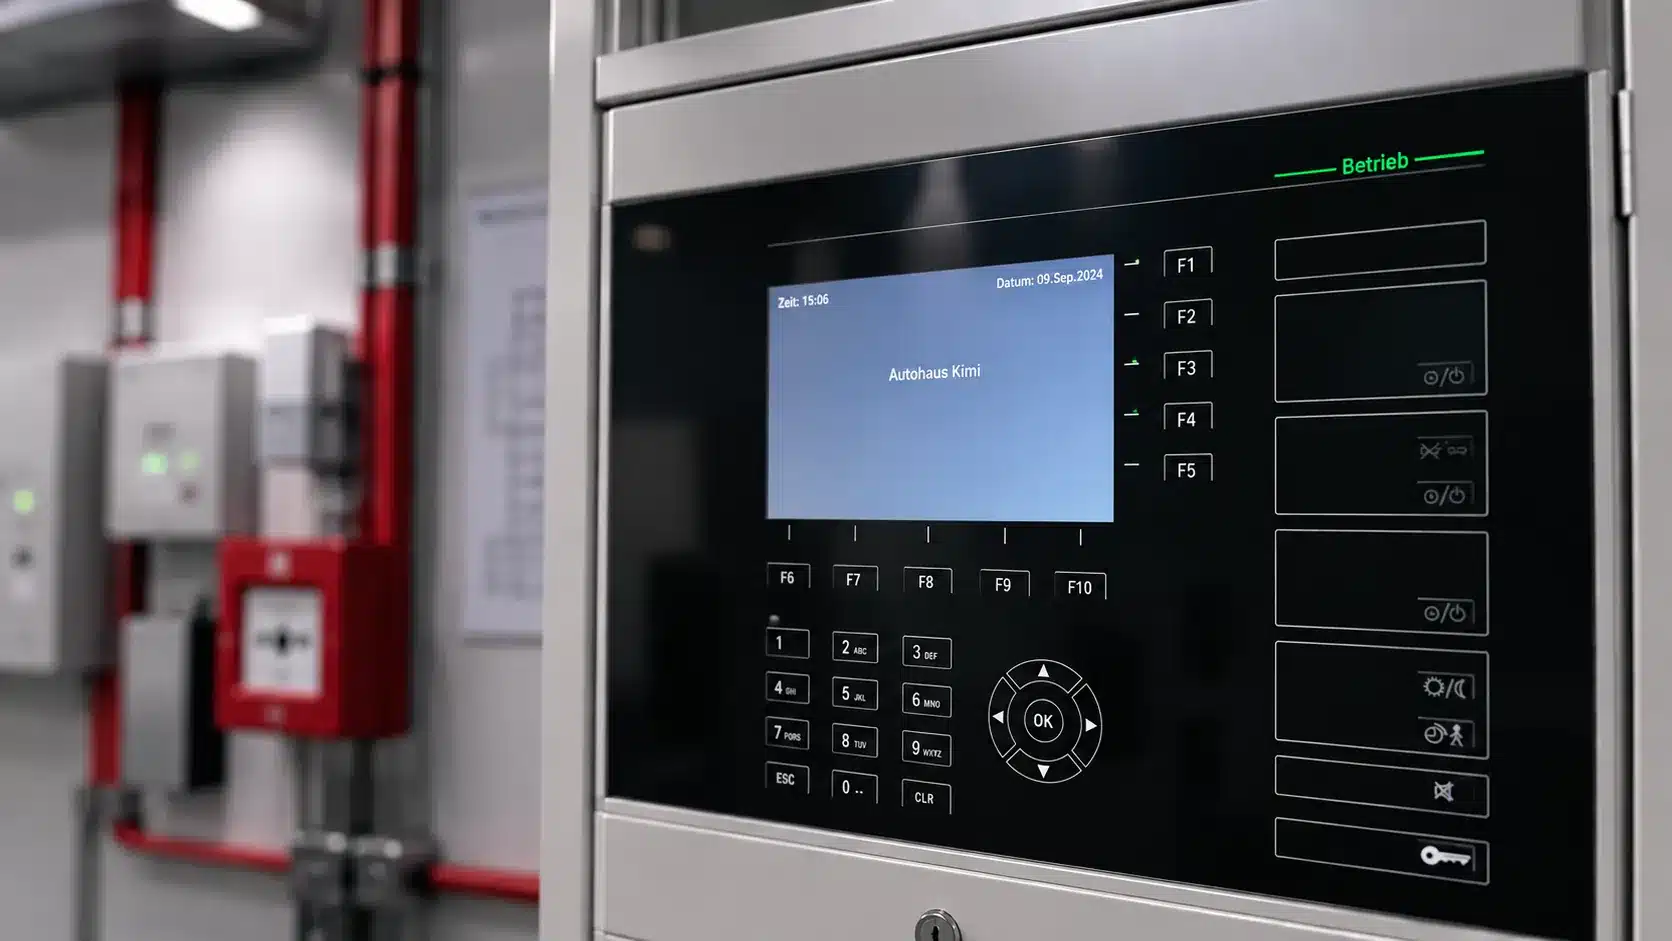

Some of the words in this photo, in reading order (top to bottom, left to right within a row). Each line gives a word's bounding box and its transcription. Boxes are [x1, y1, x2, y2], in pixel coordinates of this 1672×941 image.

[1342, 151, 1409, 175] Betrieb
[1177, 256, 1194, 274] F1
[996, 276, 1035, 289] Datum:
[1036, 267, 1104, 286] 09.Sep.2024
[777, 296, 800, 309] Zeit:
[801, 293, 830, 307] 15:06
[1177, 308, 1196, 325] F2
[888, 365, 949, 382] Autohaus
[951, 363, 981, 380] Kimi
[1177, 360, 1197, 377] F3
[1177, 411, 1196, 428] F4
[1177, 462, 1196, 479] F5
[780, 570, 795, 585] F6
[846, 572, 861, 587] F7
[918, 574, 934, 589] F8
[995, 577, 1012, 593] F9
[1068, 580, 1093, 595] F10
[775, 635, 782, 650] 1
[841, 639, 850, 655] 2
[853, 646, 868, 656] ABC
[912, 644, 921, 660] 3
[924, 651, 939, 661] DEF
[773, 680, 783, 695] 4
[841, 685, 850, 701] 5
[912, 691, 921, 707] 6
[923, 699, 941, 709] MNO
[1033, 713, 1054, 729] OK
[773, 724, 783, 740] 7
[841, 732, 850, 748] 8
[853, 740, 867, 749] TUV
[911, 740, 921, 756] 9
[775, 771, 795, 786] ESC
[842, 779, 850, 795] 0
[914, 791, 934, 805] CLR
